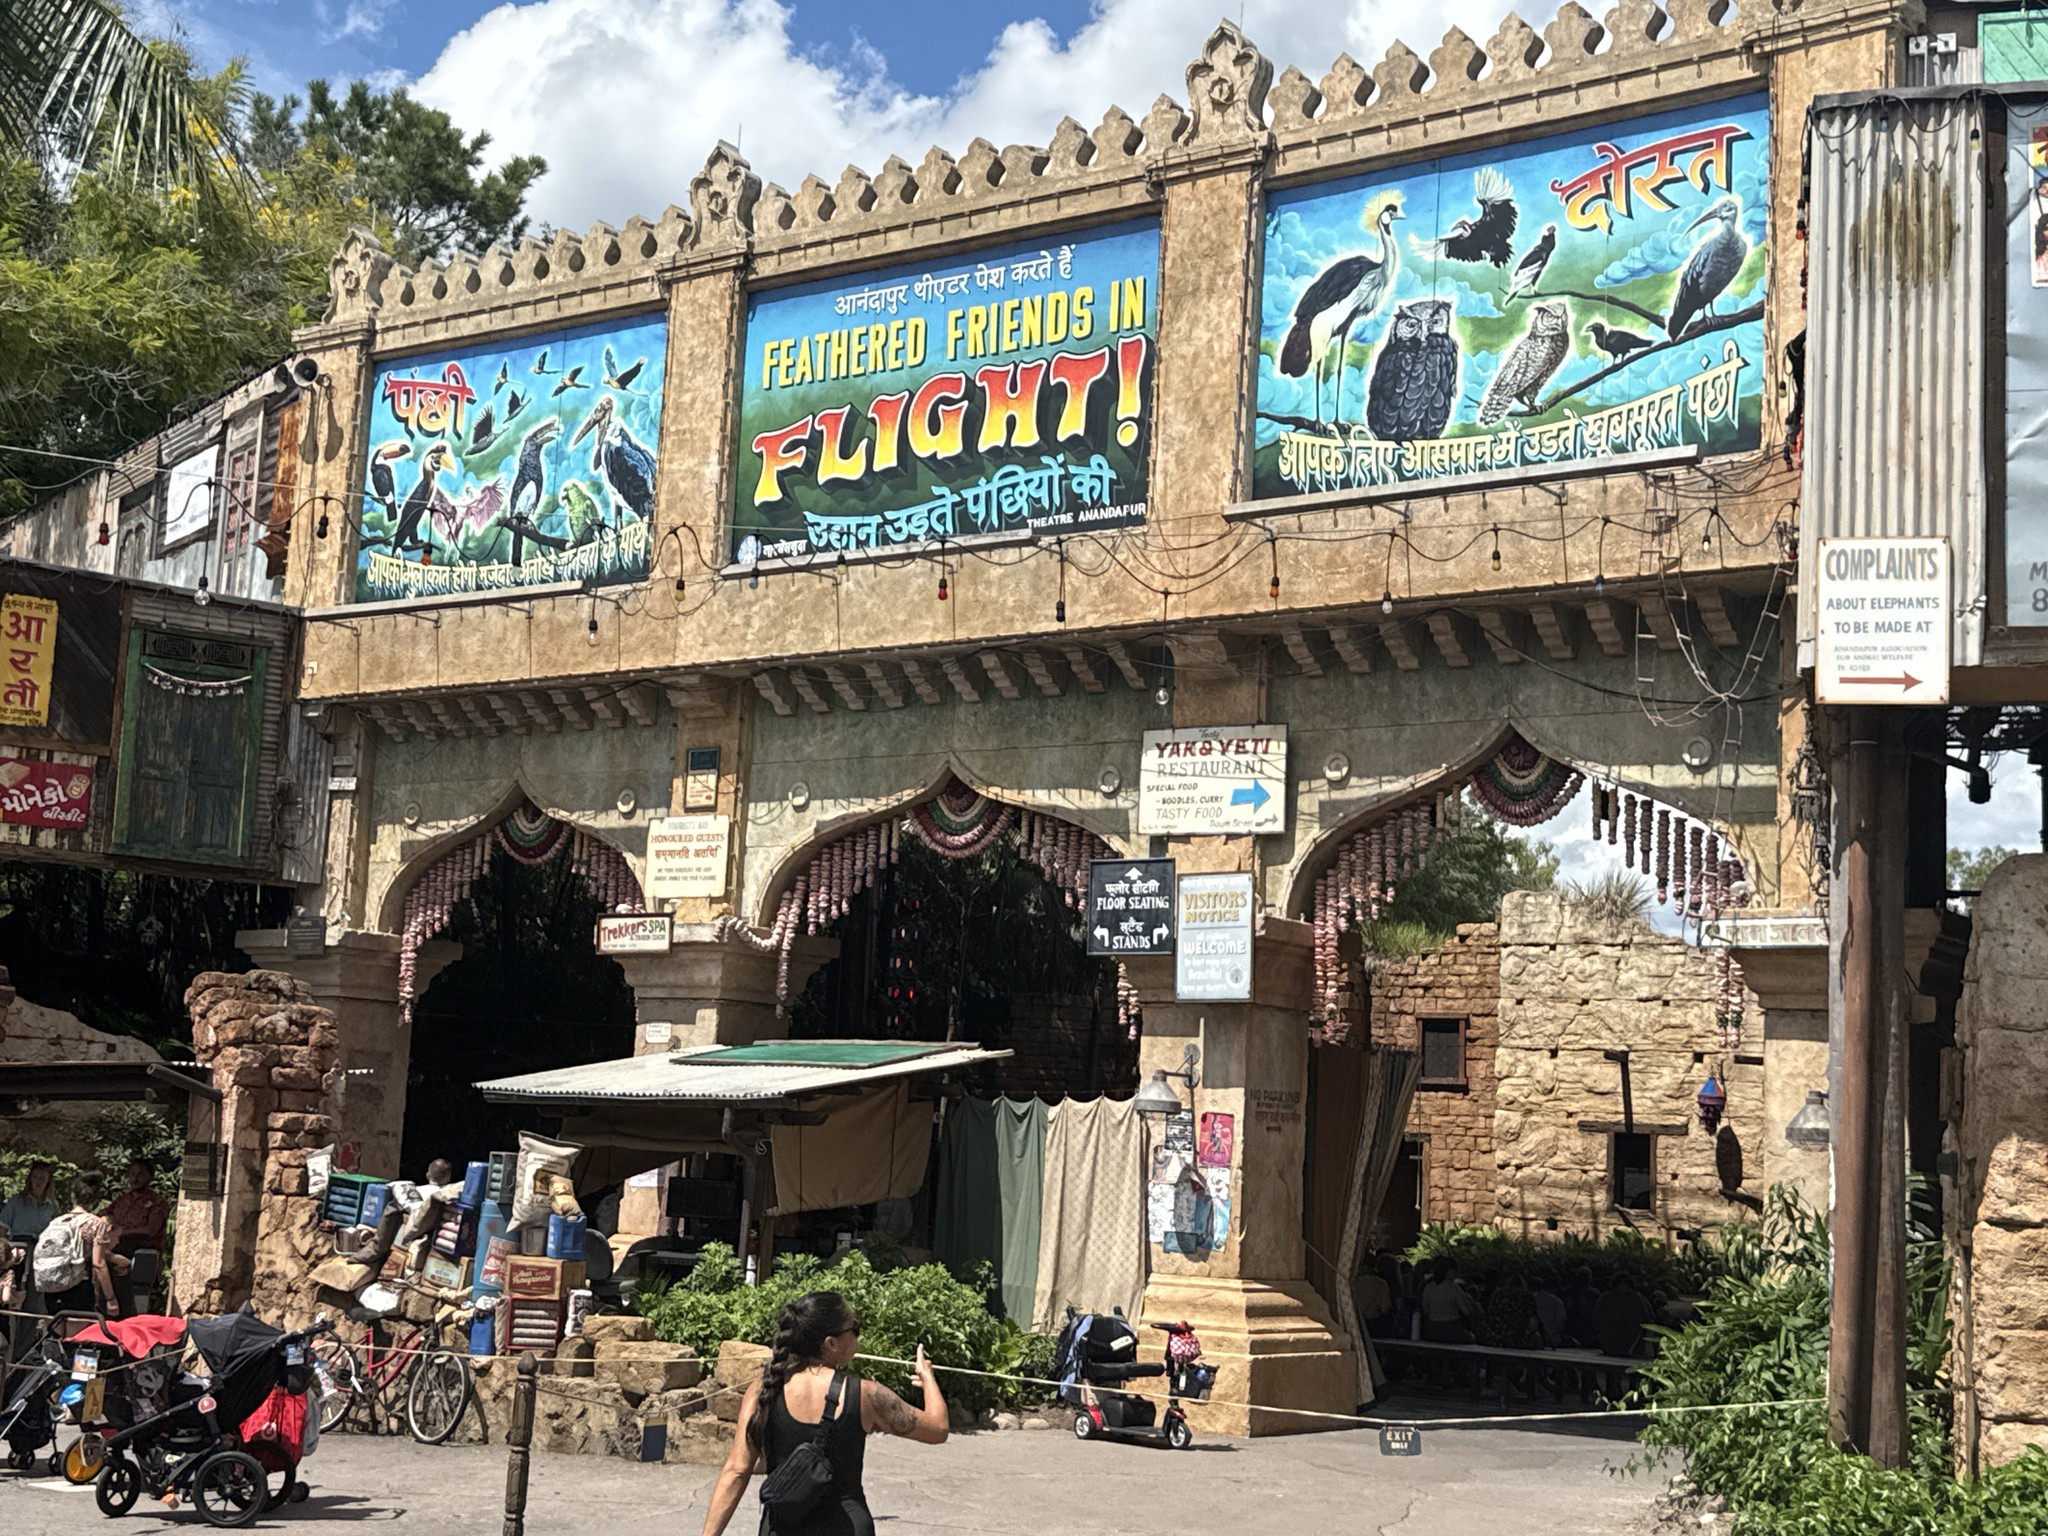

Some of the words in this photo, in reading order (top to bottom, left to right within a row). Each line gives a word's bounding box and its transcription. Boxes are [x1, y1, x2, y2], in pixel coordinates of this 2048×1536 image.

[1550, 123, 1748, 235] दोस्त
[834, 284, 908, 316] आनंदापुर
[975, 263, 1006, 291] पेश
[1011, 251, 1054, 284] करते
[1057, 244, 1076, 280] हैं
[762, 316, 927, 391] FEATHERED
[947, 286, 1095, 361] FRIENDS
[1109, 275, 1147, 333] IN
[384, 361, 476, 436] पंछी
[751, 333, 1148, 508] FLIGHT!
[1279, 424, 1347, 486] आपके
[1346, 425, 1400, 483] लिए
[1401, 434, 1497, 478] आसमान
[1493, 418, 1522, 466] में
[1686, 339, 1747, 438] पंछी
[1068, 454, 1117, 506] की
[1027, 512, 1074, 528] THEATRE
[1078, 503, 1147, 522] ANANDAPUR
[1825, 547, 1939, 581] COMPLAINTS
[1826, 598, 1867, 610] ABOUT
[1870, 597, 1940, 610] ELEPHANTS
[1834, 622, 1850, 633] TO
[1854, 622, 1869, 633] BE
[1874, 621, 1912, 633] MADE
[1915, 621, 1933, 633] AT
[1156, 760, 1266, 777] RESTAURANT
[1147, 784, 1176, 792] SPECIAL
[1178, 783, 1198, 791] FOOD
[1200, 796, 1224, 804] CURRY
[1156, 808, 1190, 820] TASTY
[1195, 807, 1223, 819] FOOD
[651, 834, 694, 843] HONOURED
[696, 833, 725, 842] GUESTS
[1096, 897, 1126, 910] FLOOR
[1128, 896, 1169, 909] SEATING
[1184, 891, 1247, 910] VISITORS
[1185, 910, 1240, 923] NOTICE
[601, 920, 648, 942] Trekkers
[648, 919, 666, 933] SPA
[1112, 935, 1151, 949] STANDS
[1183, 940, 1247, 955] WELCOME
[1386, 1431, 1413, 1441] EXIT
